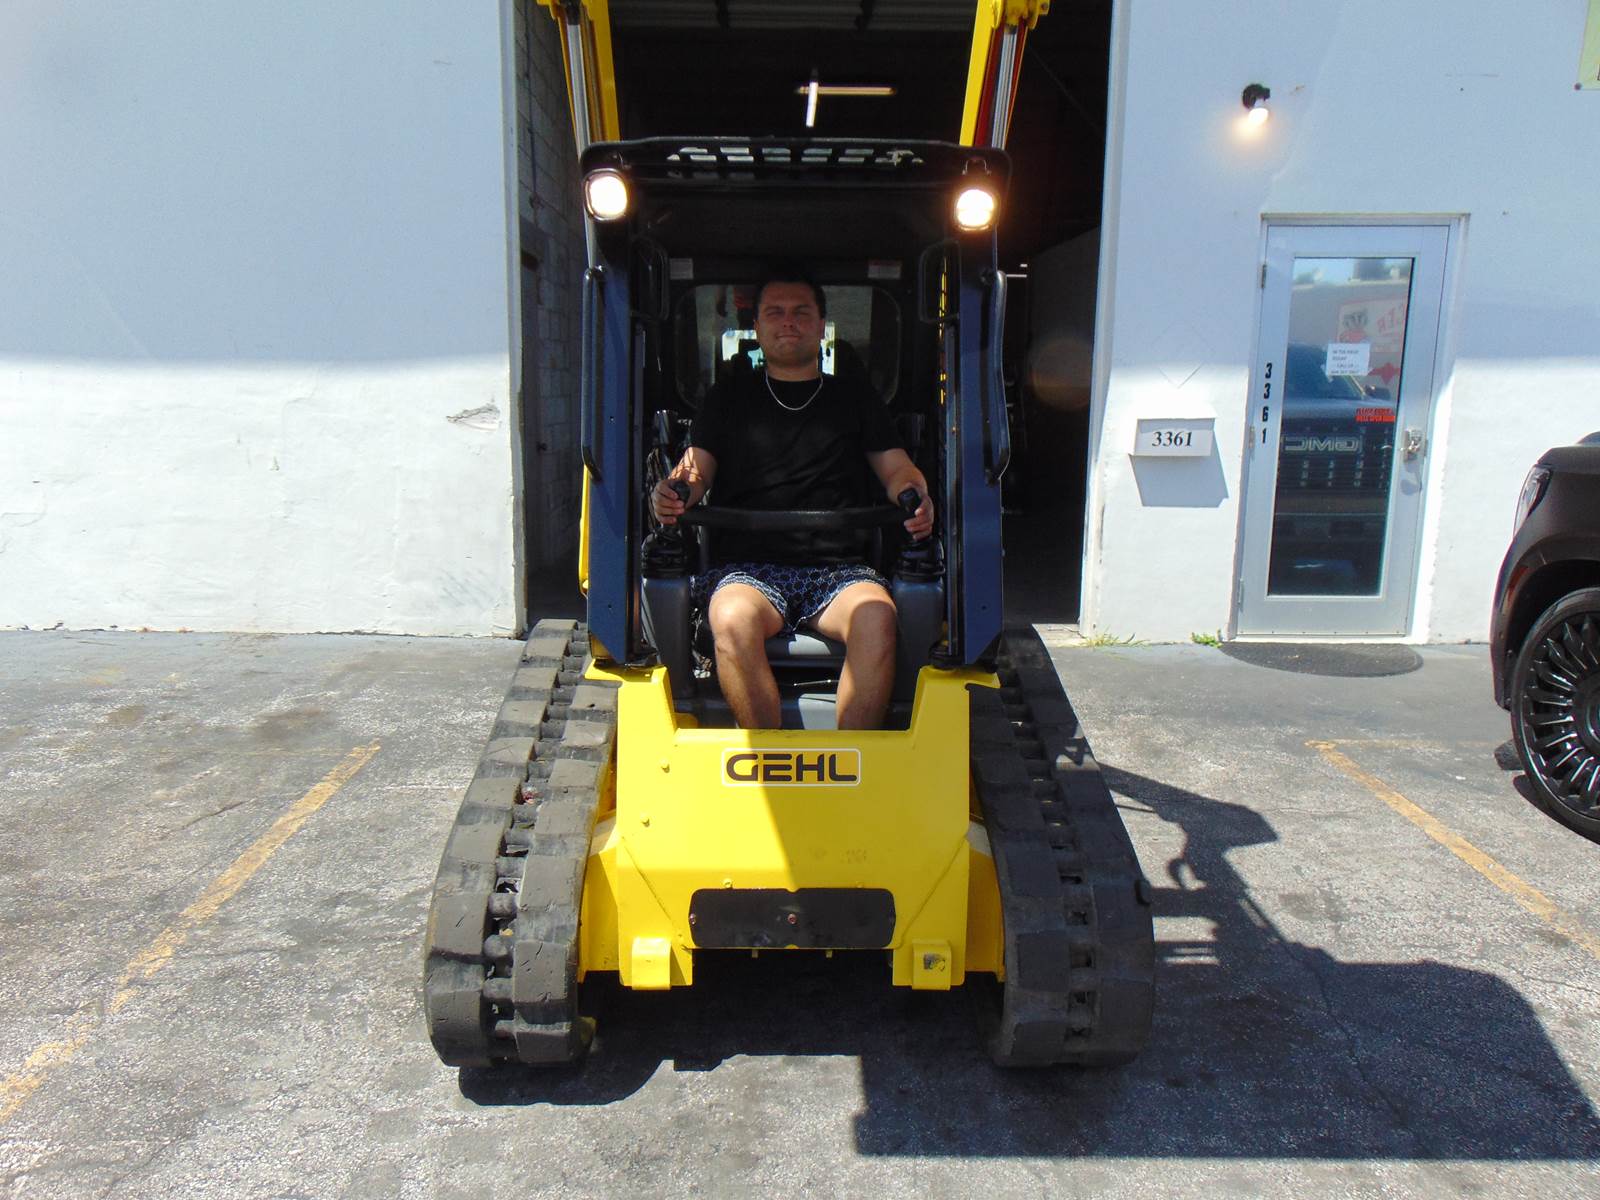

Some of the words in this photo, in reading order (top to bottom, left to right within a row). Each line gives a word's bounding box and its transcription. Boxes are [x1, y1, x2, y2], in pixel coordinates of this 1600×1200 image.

[1261, 362, 1273, 444] 3361
[1151, 431, 1193, 447] 3361
[726, 753, 857, 781] GEHL
